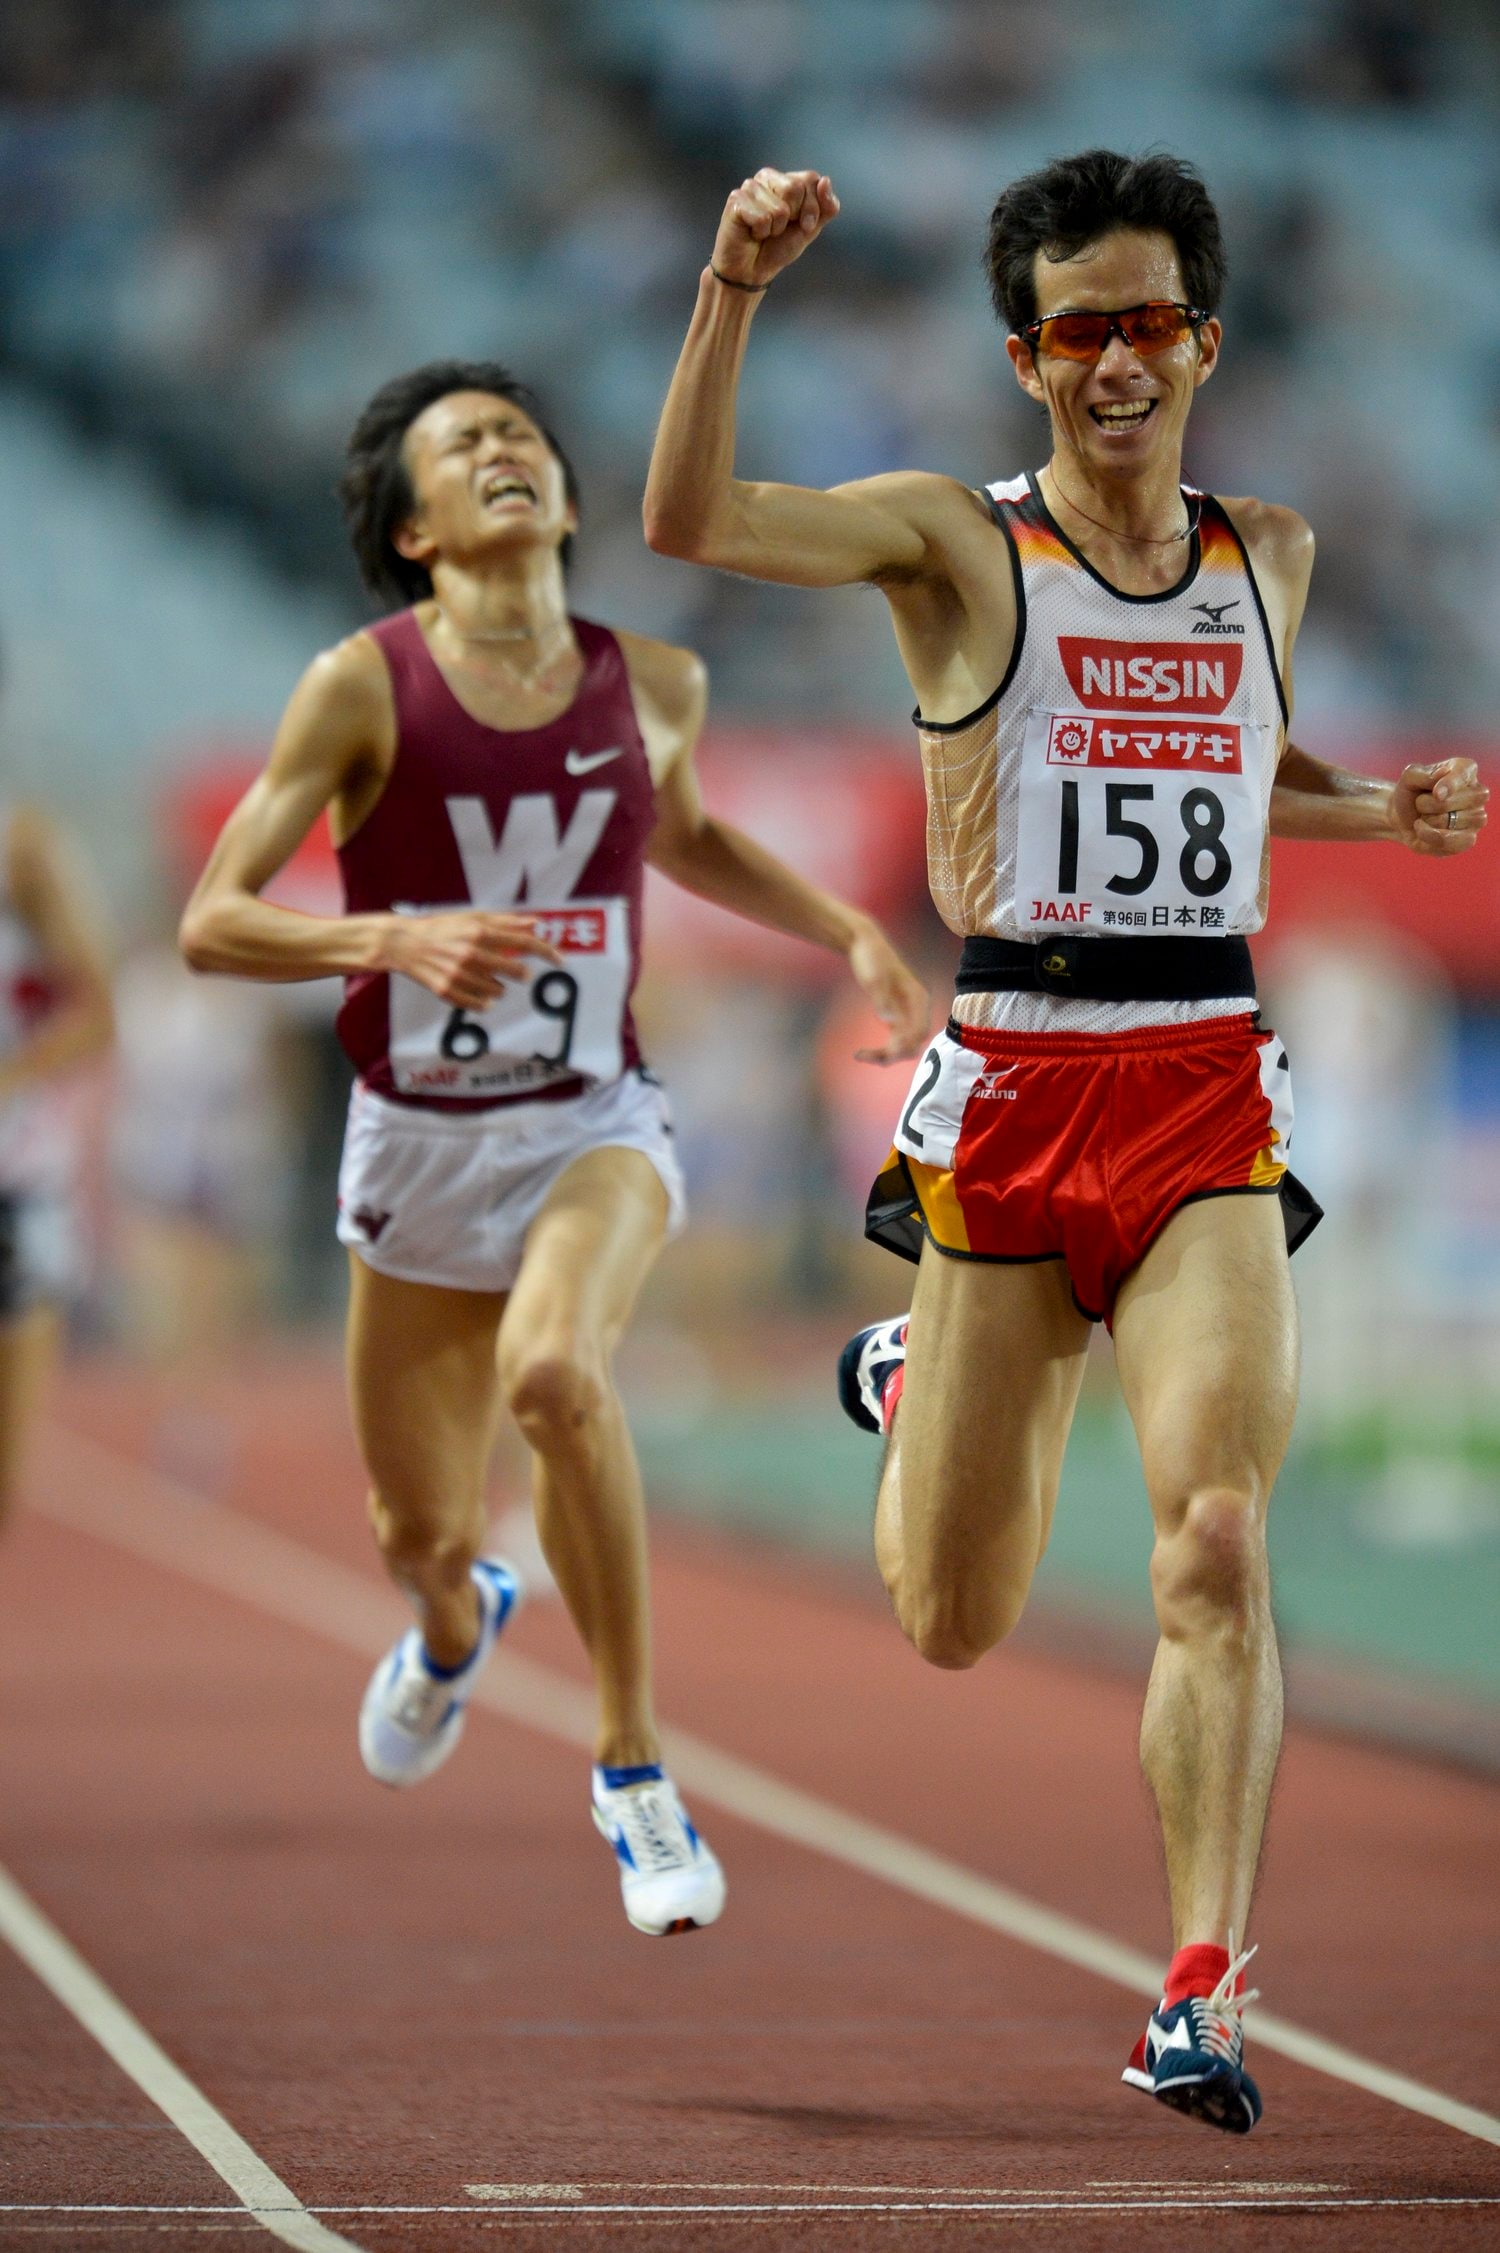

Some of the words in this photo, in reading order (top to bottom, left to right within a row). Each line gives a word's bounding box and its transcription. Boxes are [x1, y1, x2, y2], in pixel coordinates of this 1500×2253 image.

[1081, 656, 1225, 702] NISSIN
[1098, 728, 1233, 763] ヤマザキ
[446, 789, 617, 905] W
[1058, 780, 1232, 897] 158
[1030, 902, 1092, 922] JAAF
[901, 1047, 940, 1149] 2
